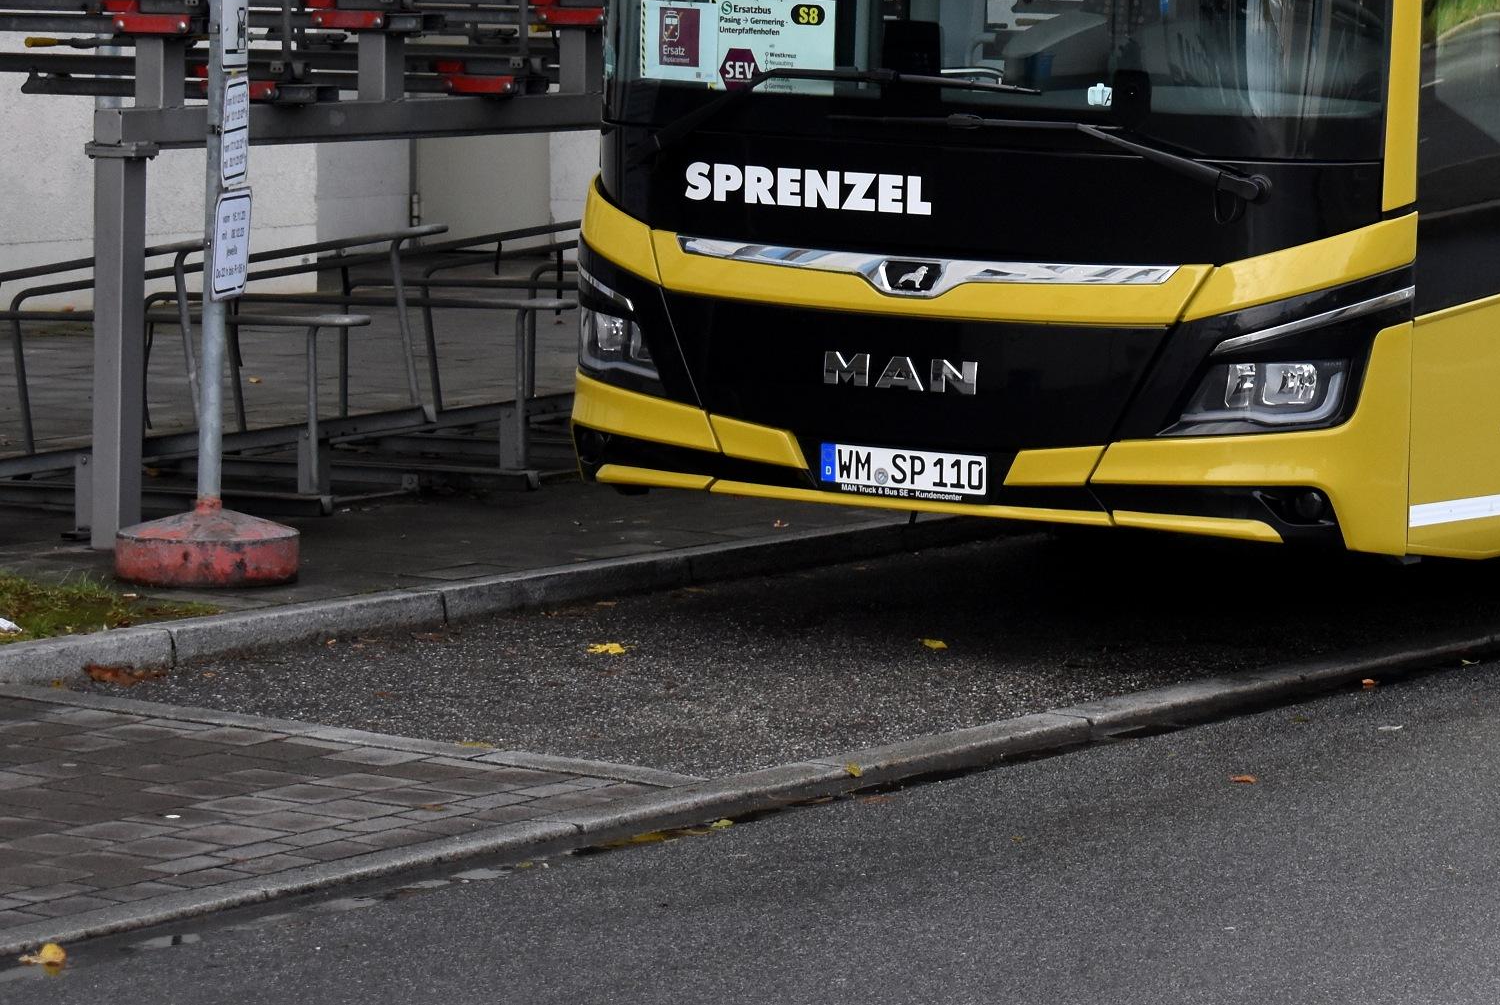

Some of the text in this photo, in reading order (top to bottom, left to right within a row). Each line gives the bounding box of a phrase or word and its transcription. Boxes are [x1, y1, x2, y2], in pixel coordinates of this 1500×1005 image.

[734, 4, 772, 15] Ersatzbus
[799, 6, 819, 24] S8
[720, 15, 742, 26] Pasing
[750, 17, 785, 28] Germering
[719, 26, 780, 36] Unterpfaffenhofen
[662, 45, 685, 56] Ersatz
[725, 61, 755, 79] SEV
[684, 160, 932, 216] SPRENZEL
[823, 350, 980, 395] MAN
[825, 466, 832, 475] D
[838, 448, 984, 491] WM SP 110
[841, 483, 857, 492] MAN
[859, 485, 877, 494] Truck
[878, 486, 883, 494] &
[885, 487, 898, 496] Bus
[899, 488, 909, 497] SE
[915, 490, 963, 501] Kundencenter
